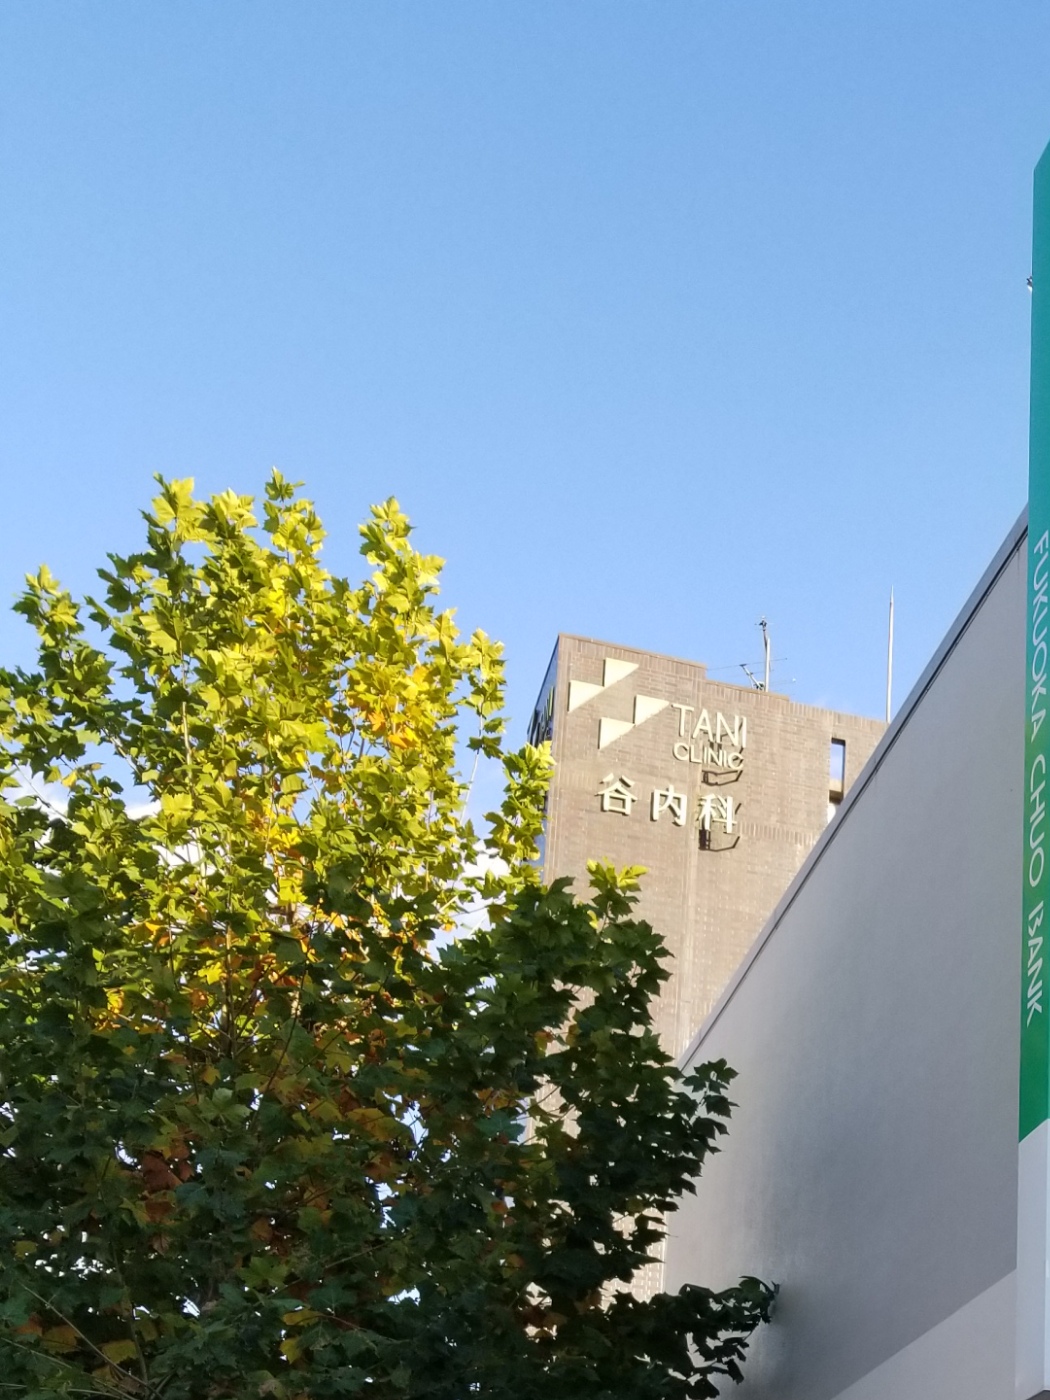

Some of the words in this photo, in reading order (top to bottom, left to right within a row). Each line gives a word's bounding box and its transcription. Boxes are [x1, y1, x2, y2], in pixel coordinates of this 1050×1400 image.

[1031, 529, 1049, 743] FUKUOKA
[671, 703, 747, 749] TANI
[673, 741, 744, 770] CLINIC
[595, 773, 738, 834] 谷内科
[1028, 753, 1046, 888] CHUO
[1026, 900, 1044, 1028] BANK
